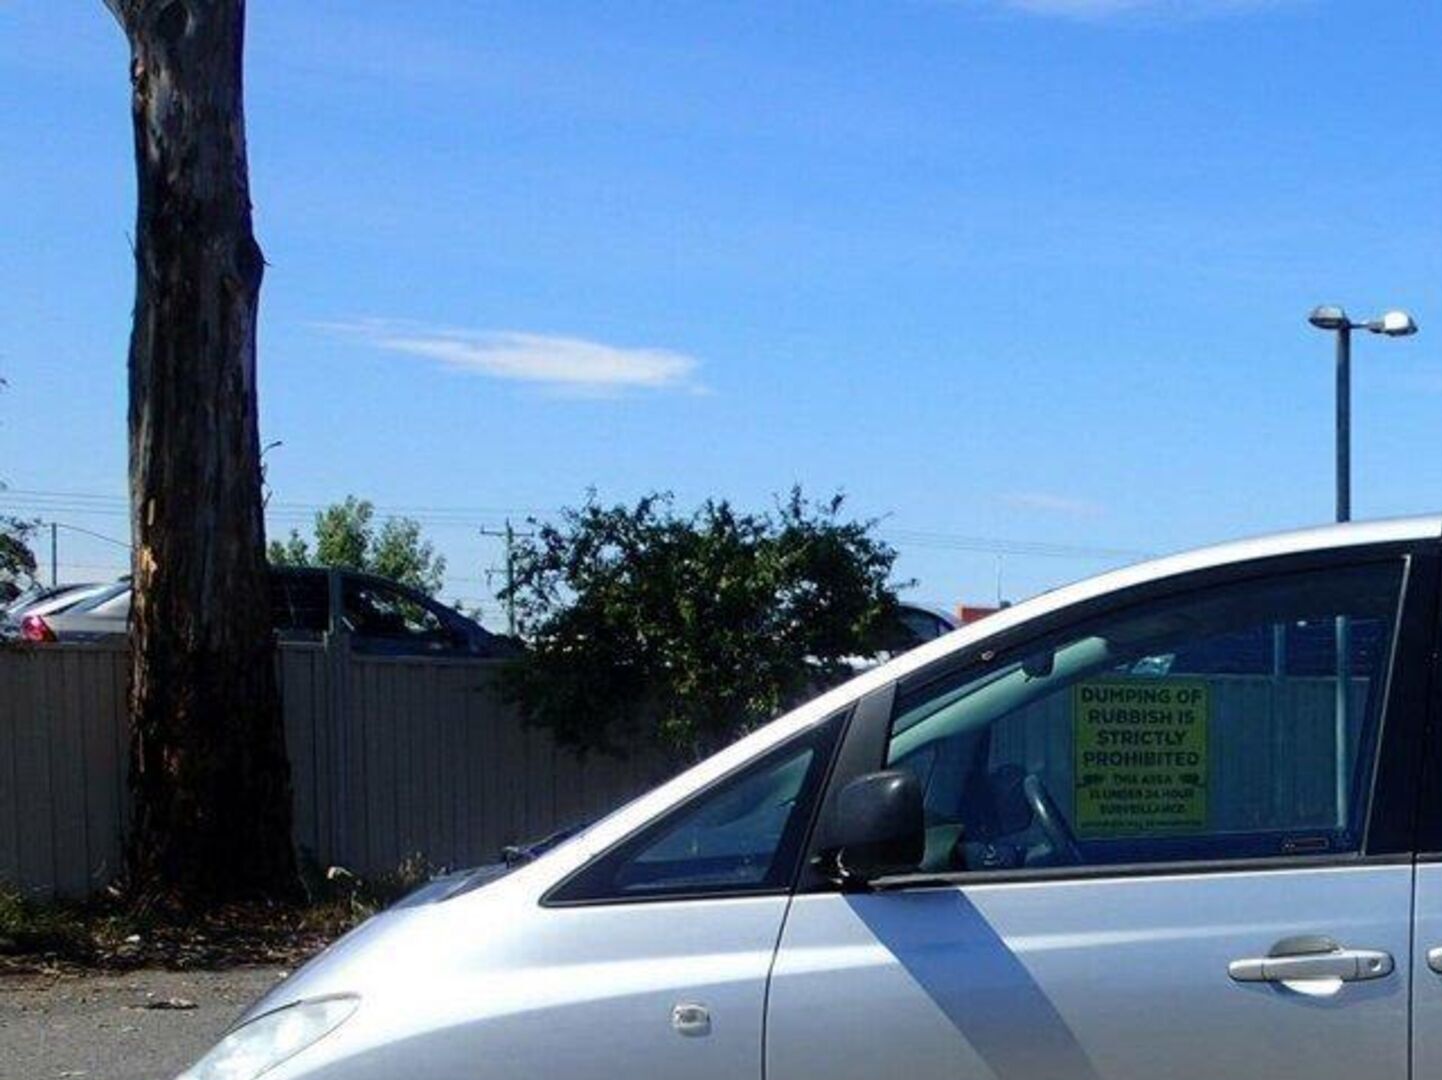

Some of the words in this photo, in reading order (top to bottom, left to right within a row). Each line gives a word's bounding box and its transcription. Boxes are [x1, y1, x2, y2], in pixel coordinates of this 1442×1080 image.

[1081, 687, 1170, 703] DUMPING
[1177, 689, 1202, 703] OF
[1088, 709, 1172, 724] RUBBISH
[1178, 710, 1194, 724] IS
[1096, 729, 1186, 745] STRICTLY
[1083, 751, 1199, 766] PROHIBITED
[1141, 774, 1172, 784] AREA
[1103, 789, 1142, 799] UNDER
[1144, 789, 1160, 799] 24
[1162, 789, 1194, 799] HOUR
